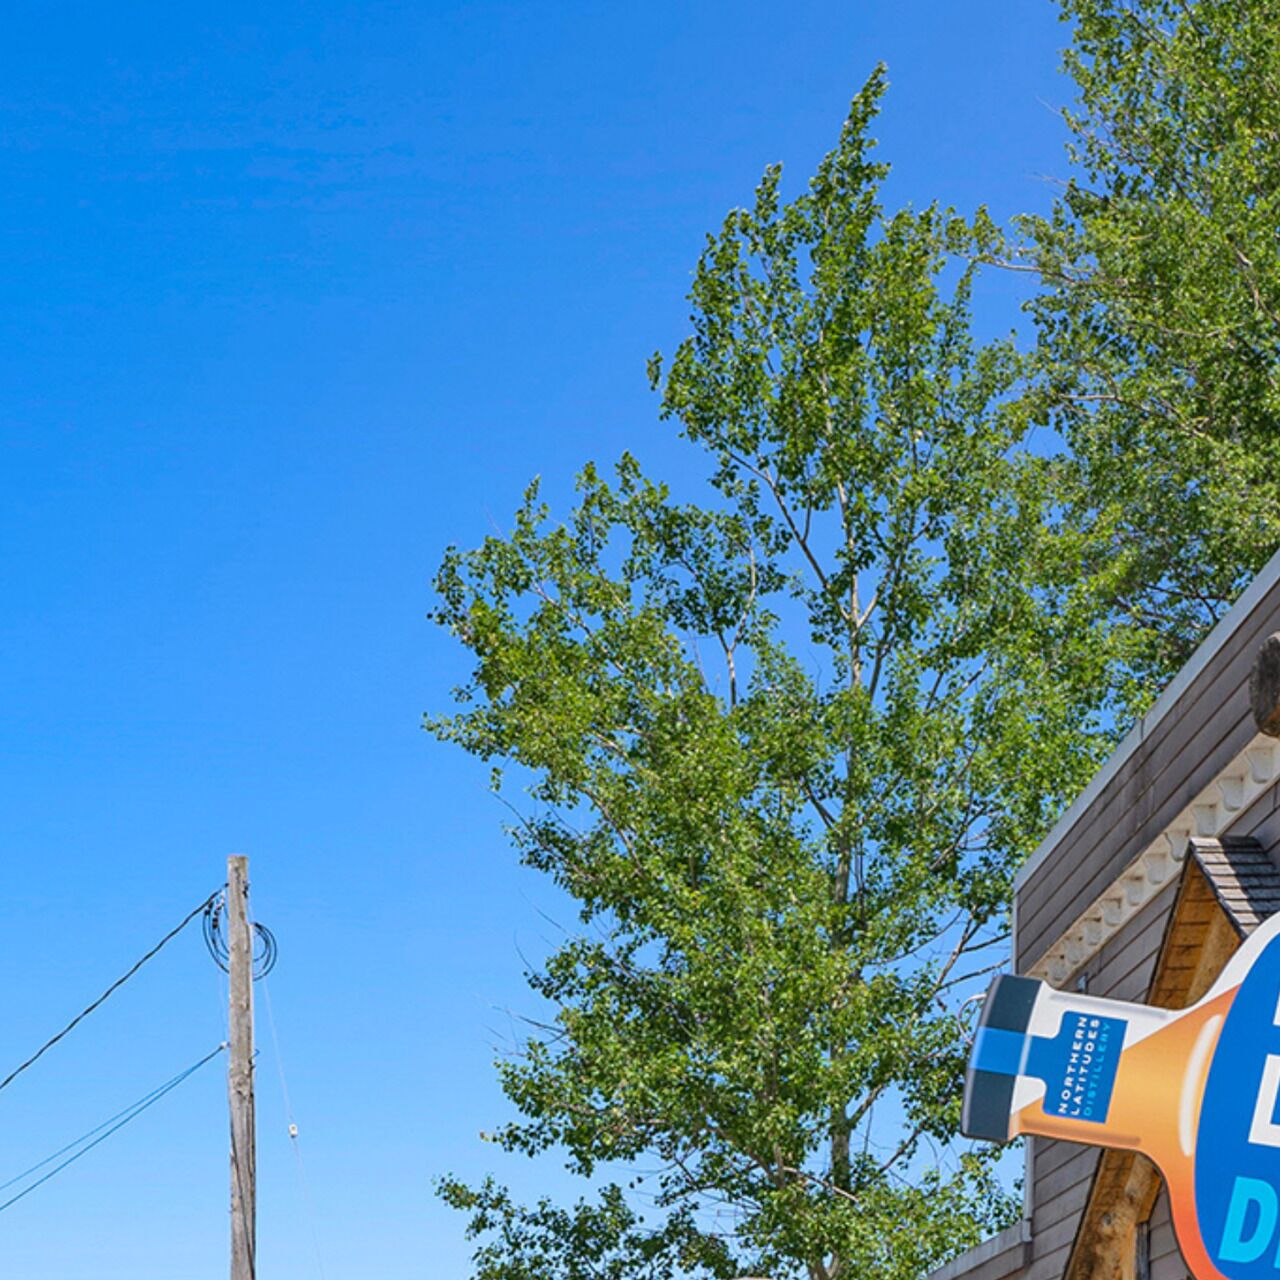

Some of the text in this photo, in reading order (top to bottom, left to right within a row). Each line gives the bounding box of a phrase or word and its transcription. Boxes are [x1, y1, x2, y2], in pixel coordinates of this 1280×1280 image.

[1058, 1016, 1087, 1114] NORTHERN
[1070, 1019, 1100, 1116] LATITUDES
[1083, 1022, 1111, 1116] DISTILLERY
